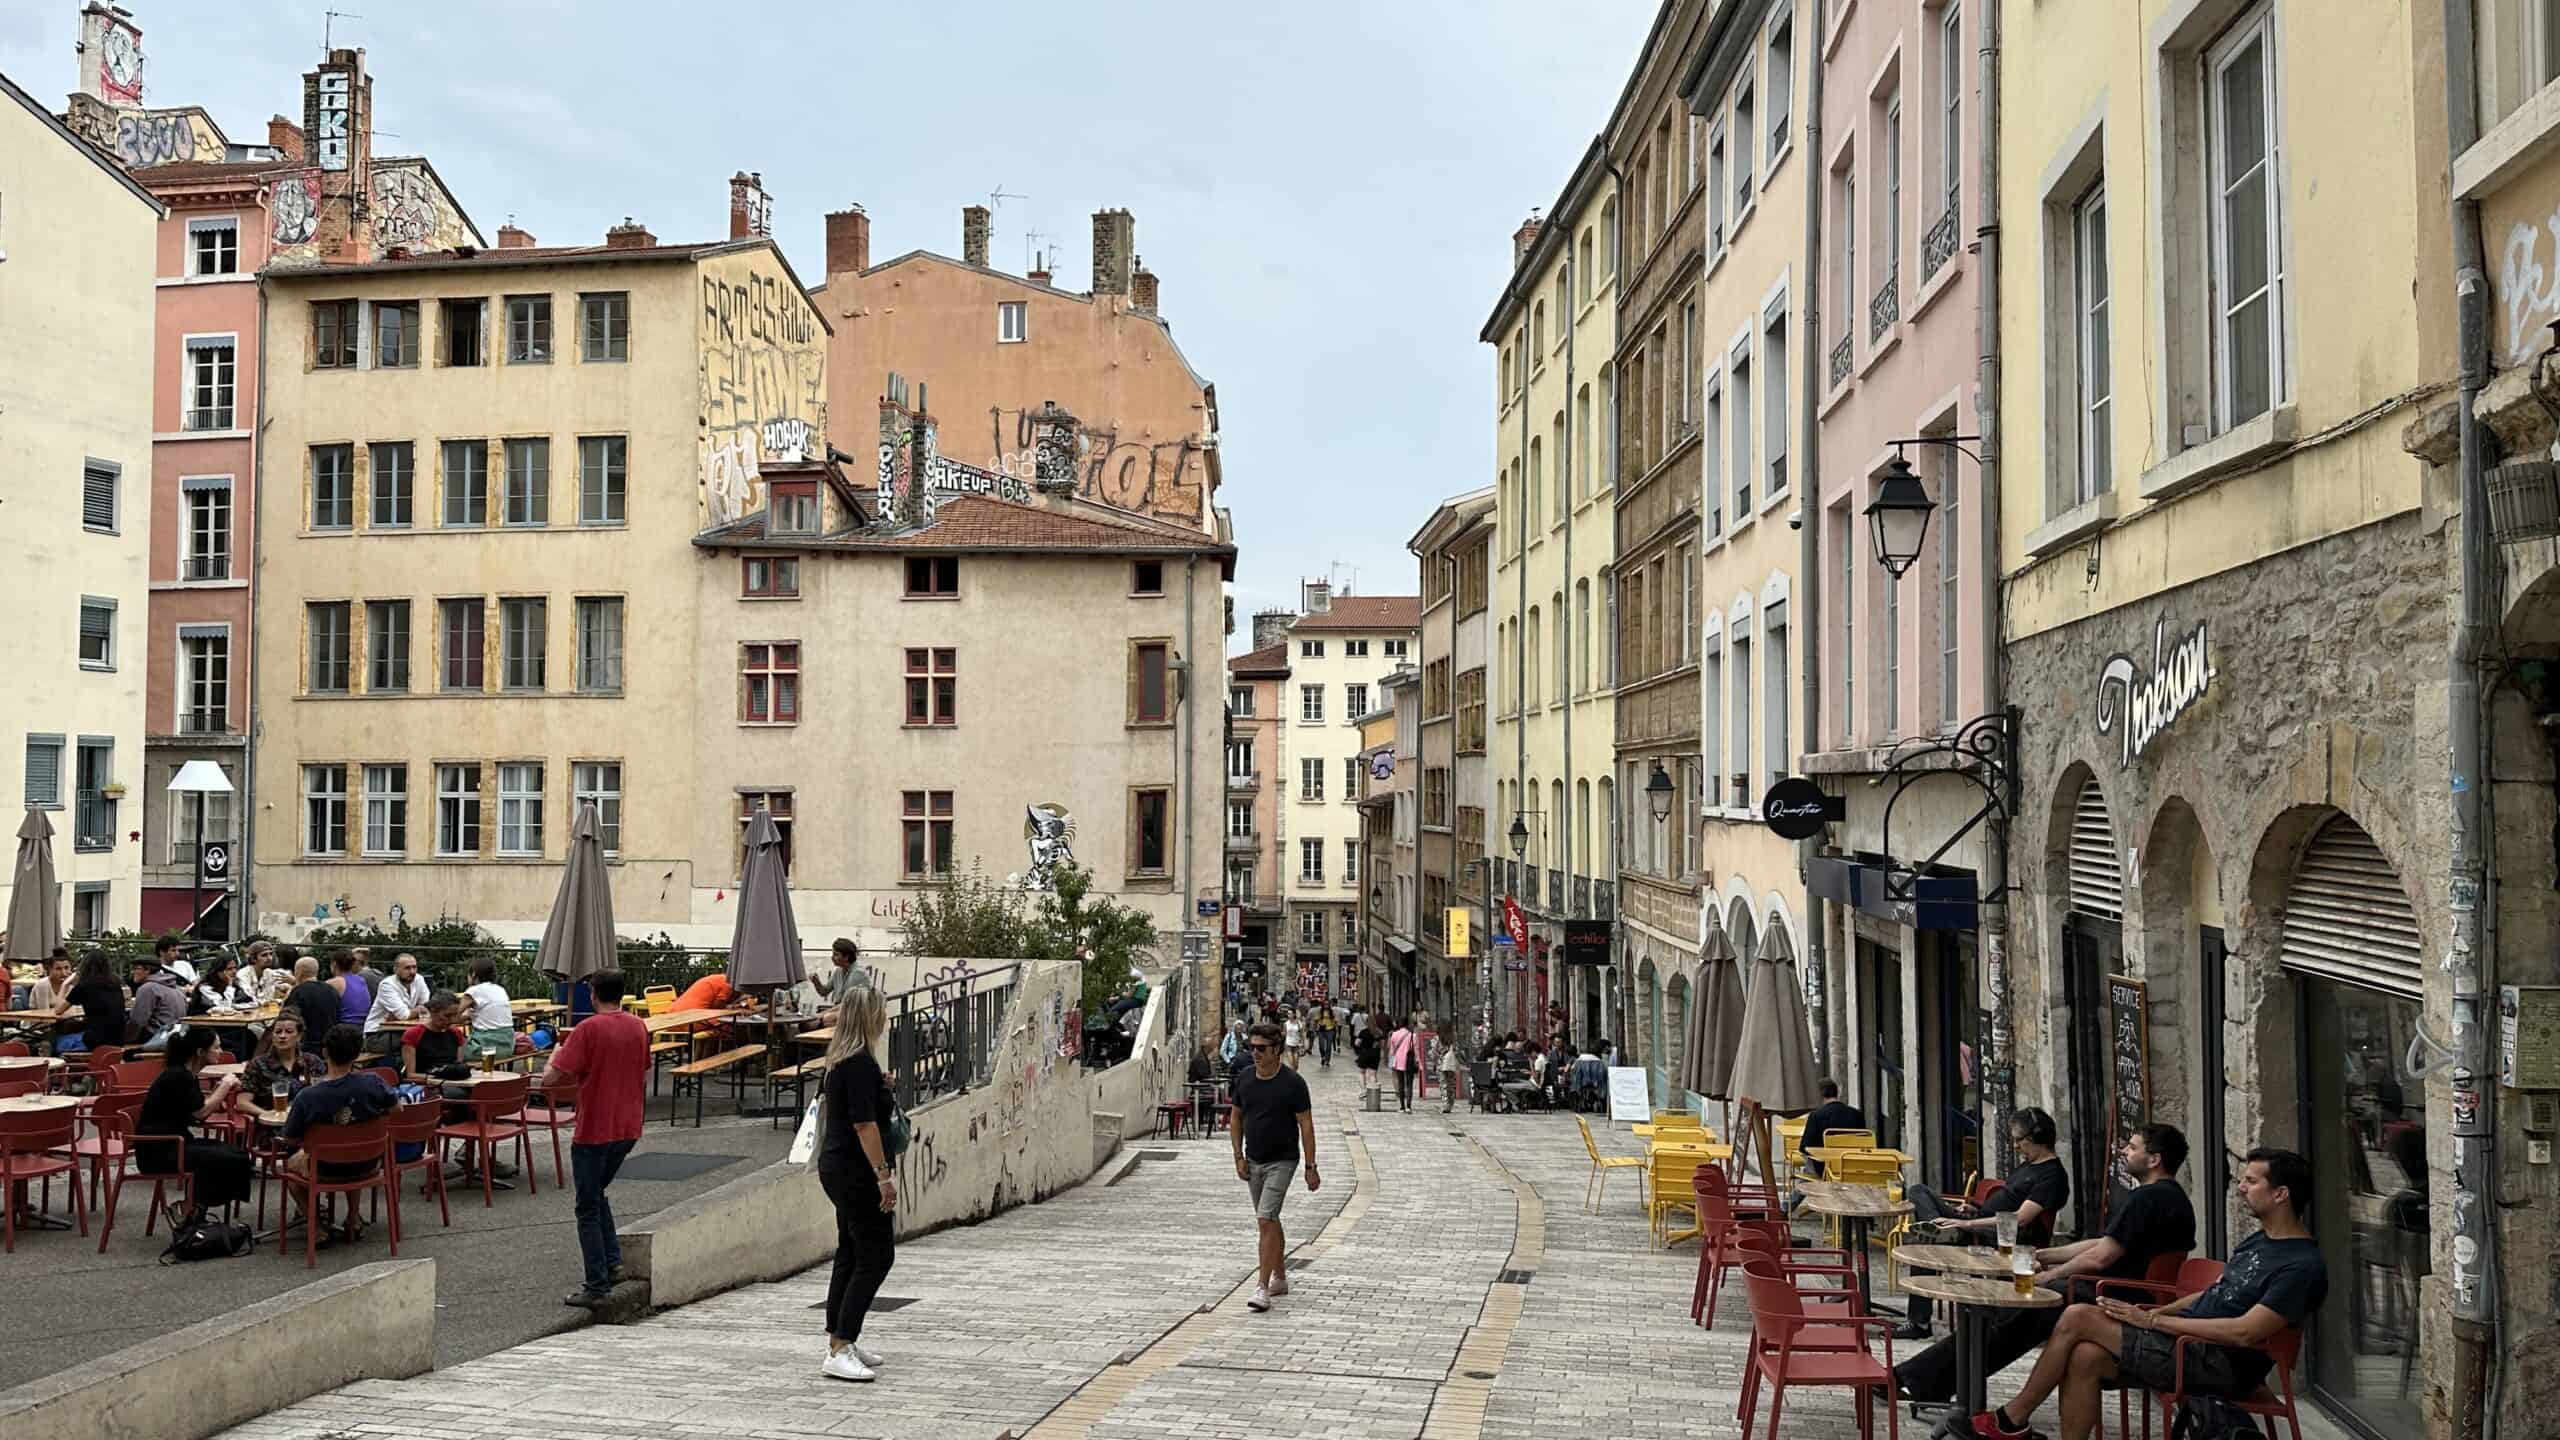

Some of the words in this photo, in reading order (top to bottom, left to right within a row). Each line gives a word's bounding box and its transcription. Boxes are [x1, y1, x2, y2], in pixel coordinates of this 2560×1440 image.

[1769, 799, 1823, 818] Quartier
[1507, 906, 1525, 942] TABAC
[2112, 985, 2141, 1009] SERVICE
